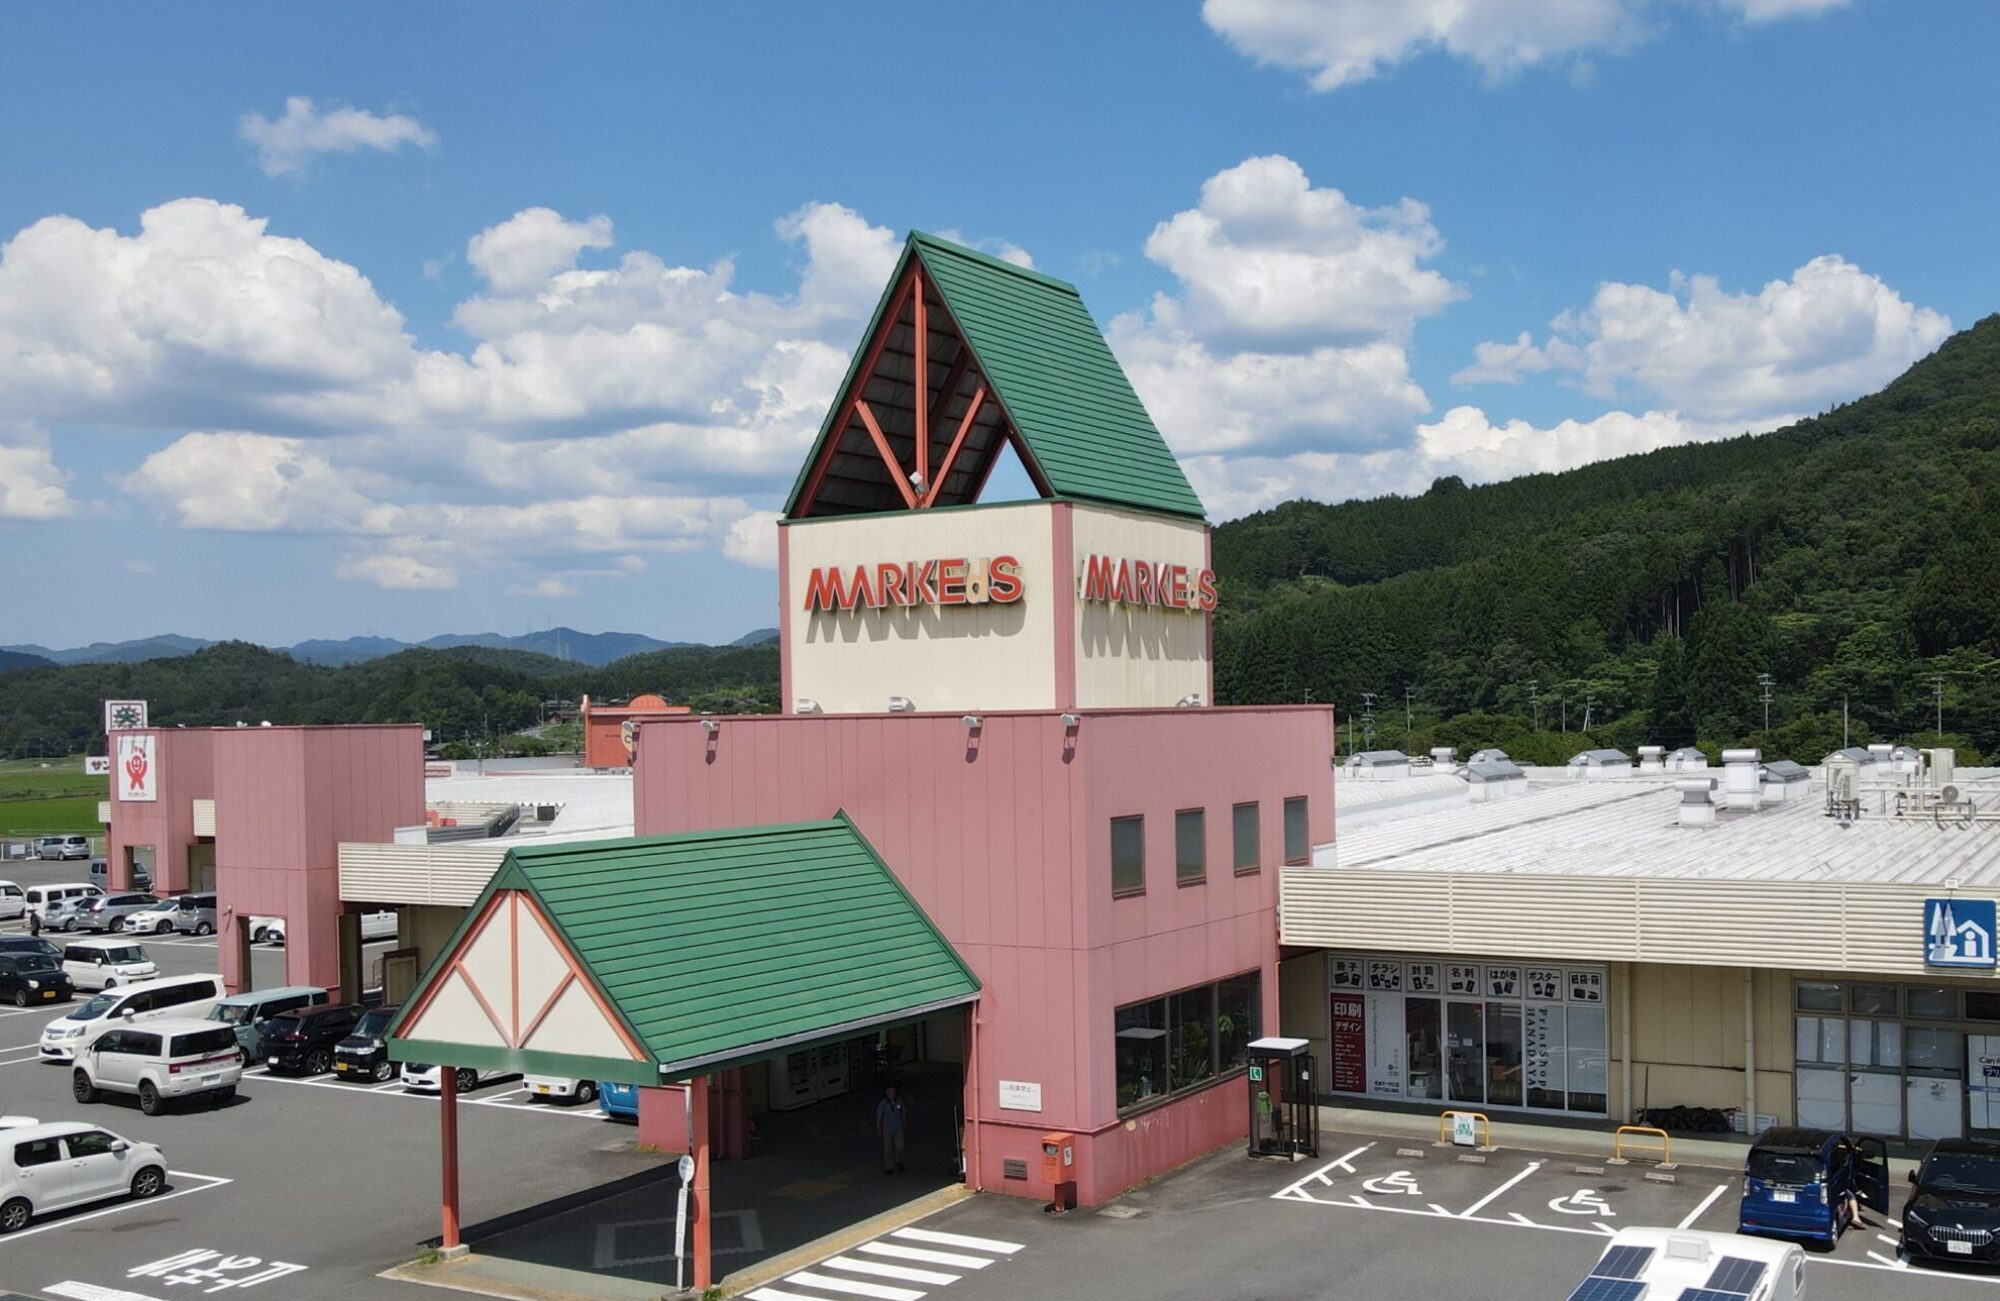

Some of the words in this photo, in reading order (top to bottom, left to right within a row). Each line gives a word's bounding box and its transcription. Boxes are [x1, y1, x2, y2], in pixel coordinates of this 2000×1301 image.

[803, 555, 1024, 611] MARKEdS
[1371, 963, 1398, 973] チラシ
[1451, 968, 1474, 978] 名刺
[1490, 970, 1517, 980] はがき
[1529, 972, 1560, 981] ポスター
[1334, 1002, 1362, 1018] 印刷
[1334, 1021, 1362, 1032] デザイン
[1527, 1008, 1537, 1086] HANADAYA
[126, 1248, 309, 1293] 止まれ
